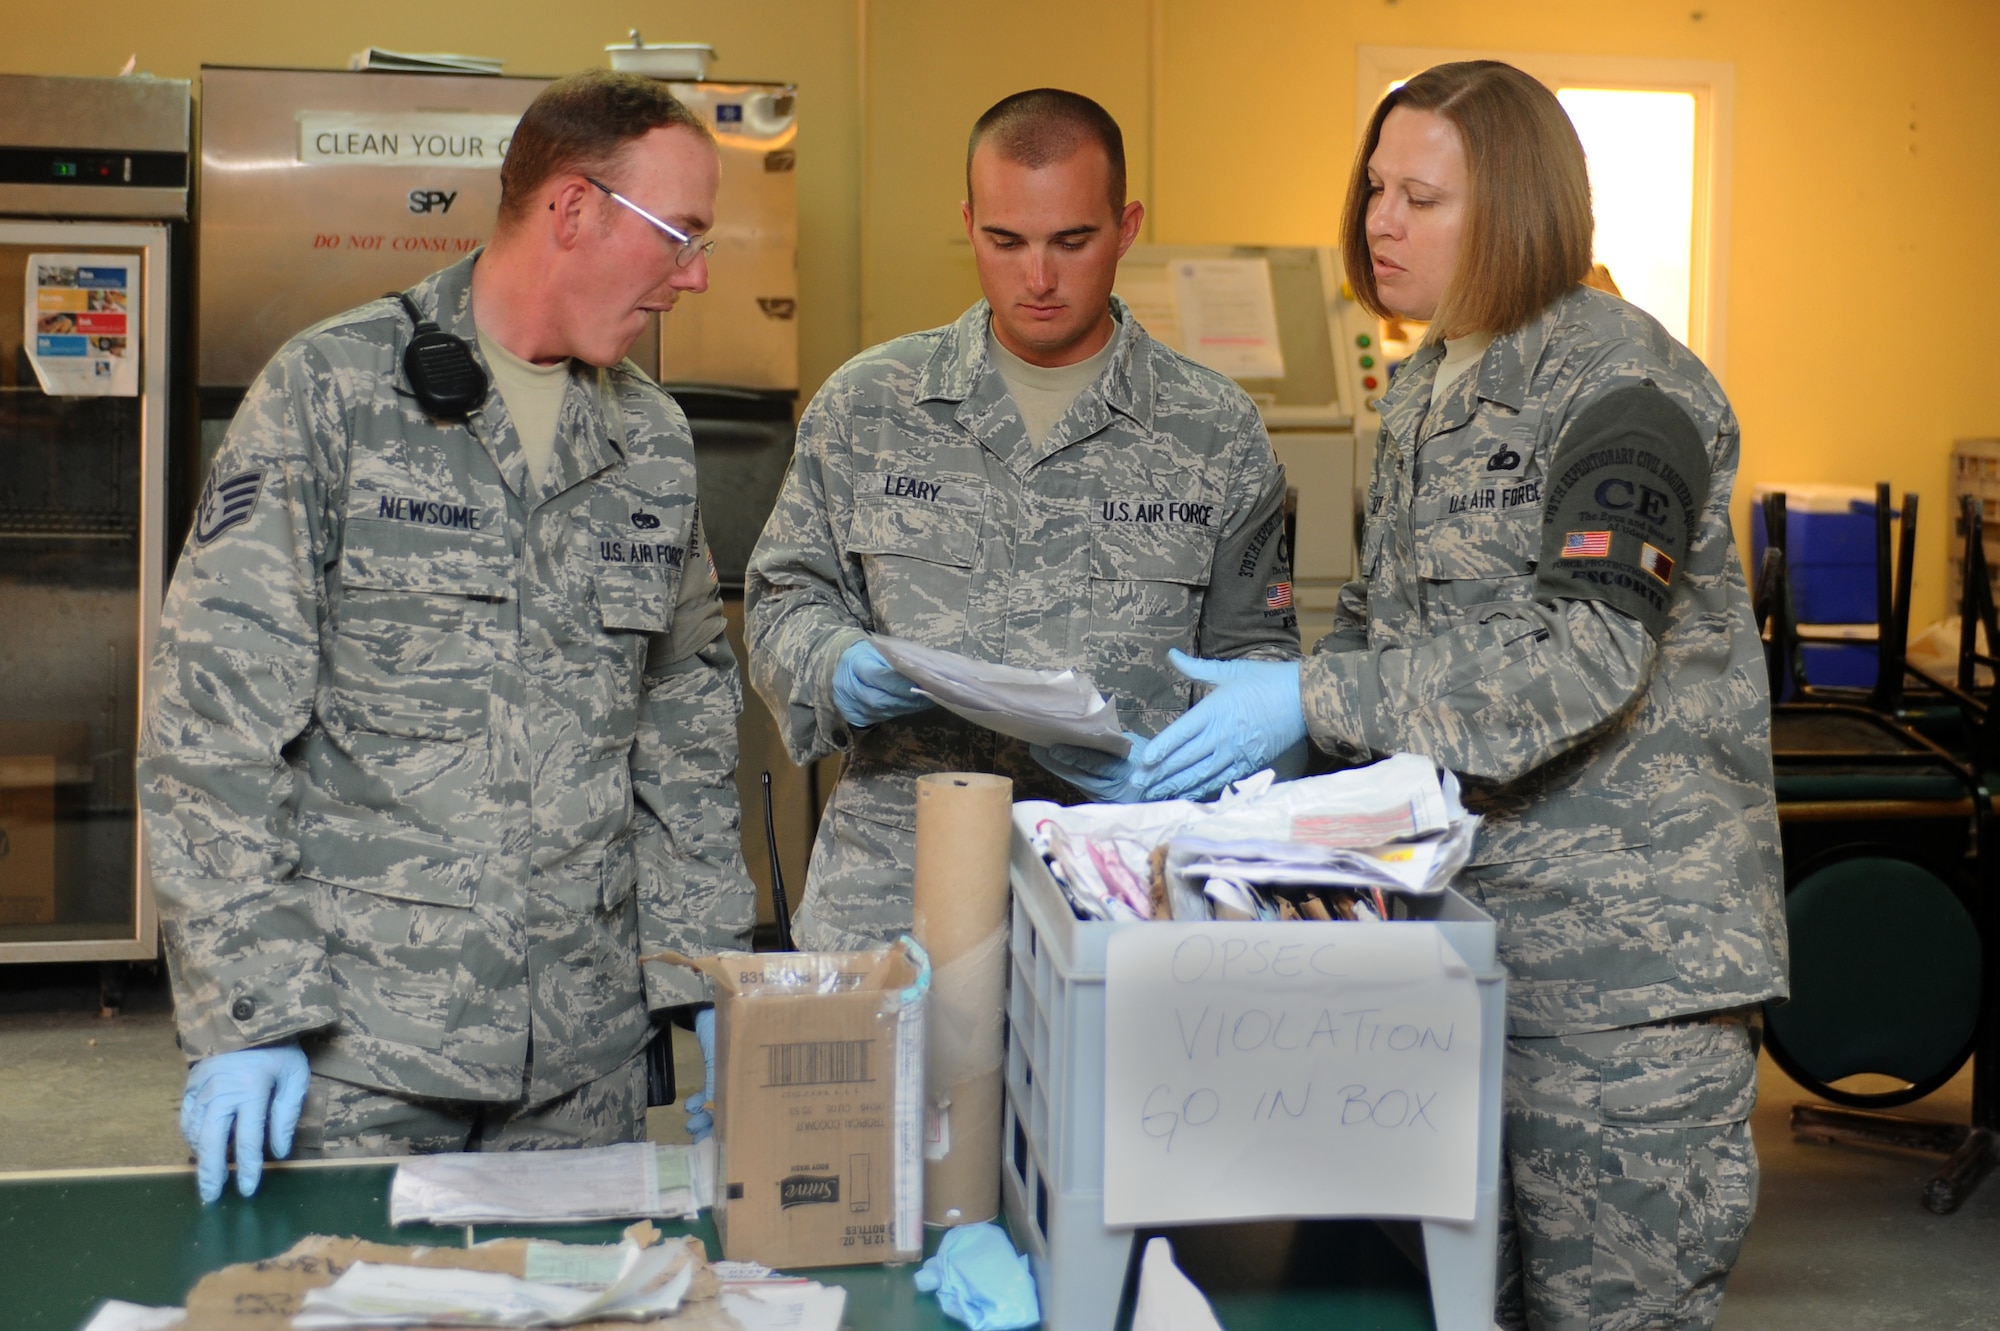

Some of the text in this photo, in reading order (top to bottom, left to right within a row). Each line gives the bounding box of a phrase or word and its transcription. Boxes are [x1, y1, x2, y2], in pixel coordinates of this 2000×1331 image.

[315, 132, 399, 156] CLEAN
[411, 134, 484, 158] YOUR
[409, 190, 458, 214] SPY
[313, 234, 341, 249] DO
[348, 235, 387, 250] NOT
[1636, 450, 1662, 476] CIVIL
[884, 475, 942, 502] LEARY
[1448, 482, 1542, 514] U.S. AIR FORCE
[378, 494, 481, 531] NEWSOME
[1102, 501, 1214, 526] U.S. AIR FORCE
[1594, 478, 1670, 526] CE
[600, 541, 626, 562] U.S.
[631, 543, 654, 563] AIR
[1238, 543, 1261, 578] 379TH
[1171, 933, 1349, 984] OPSEC
[1173, 1005, 1456, 1060] VIOLATION
[795, 1116, 885, 1132] TROPICAL COCONUT
[1141, 1081, 1439, 1153] GO IN BOX
[784, 1179, 837, 1199] Suave
[845, 1223, 886, 1235] BOTTLES
